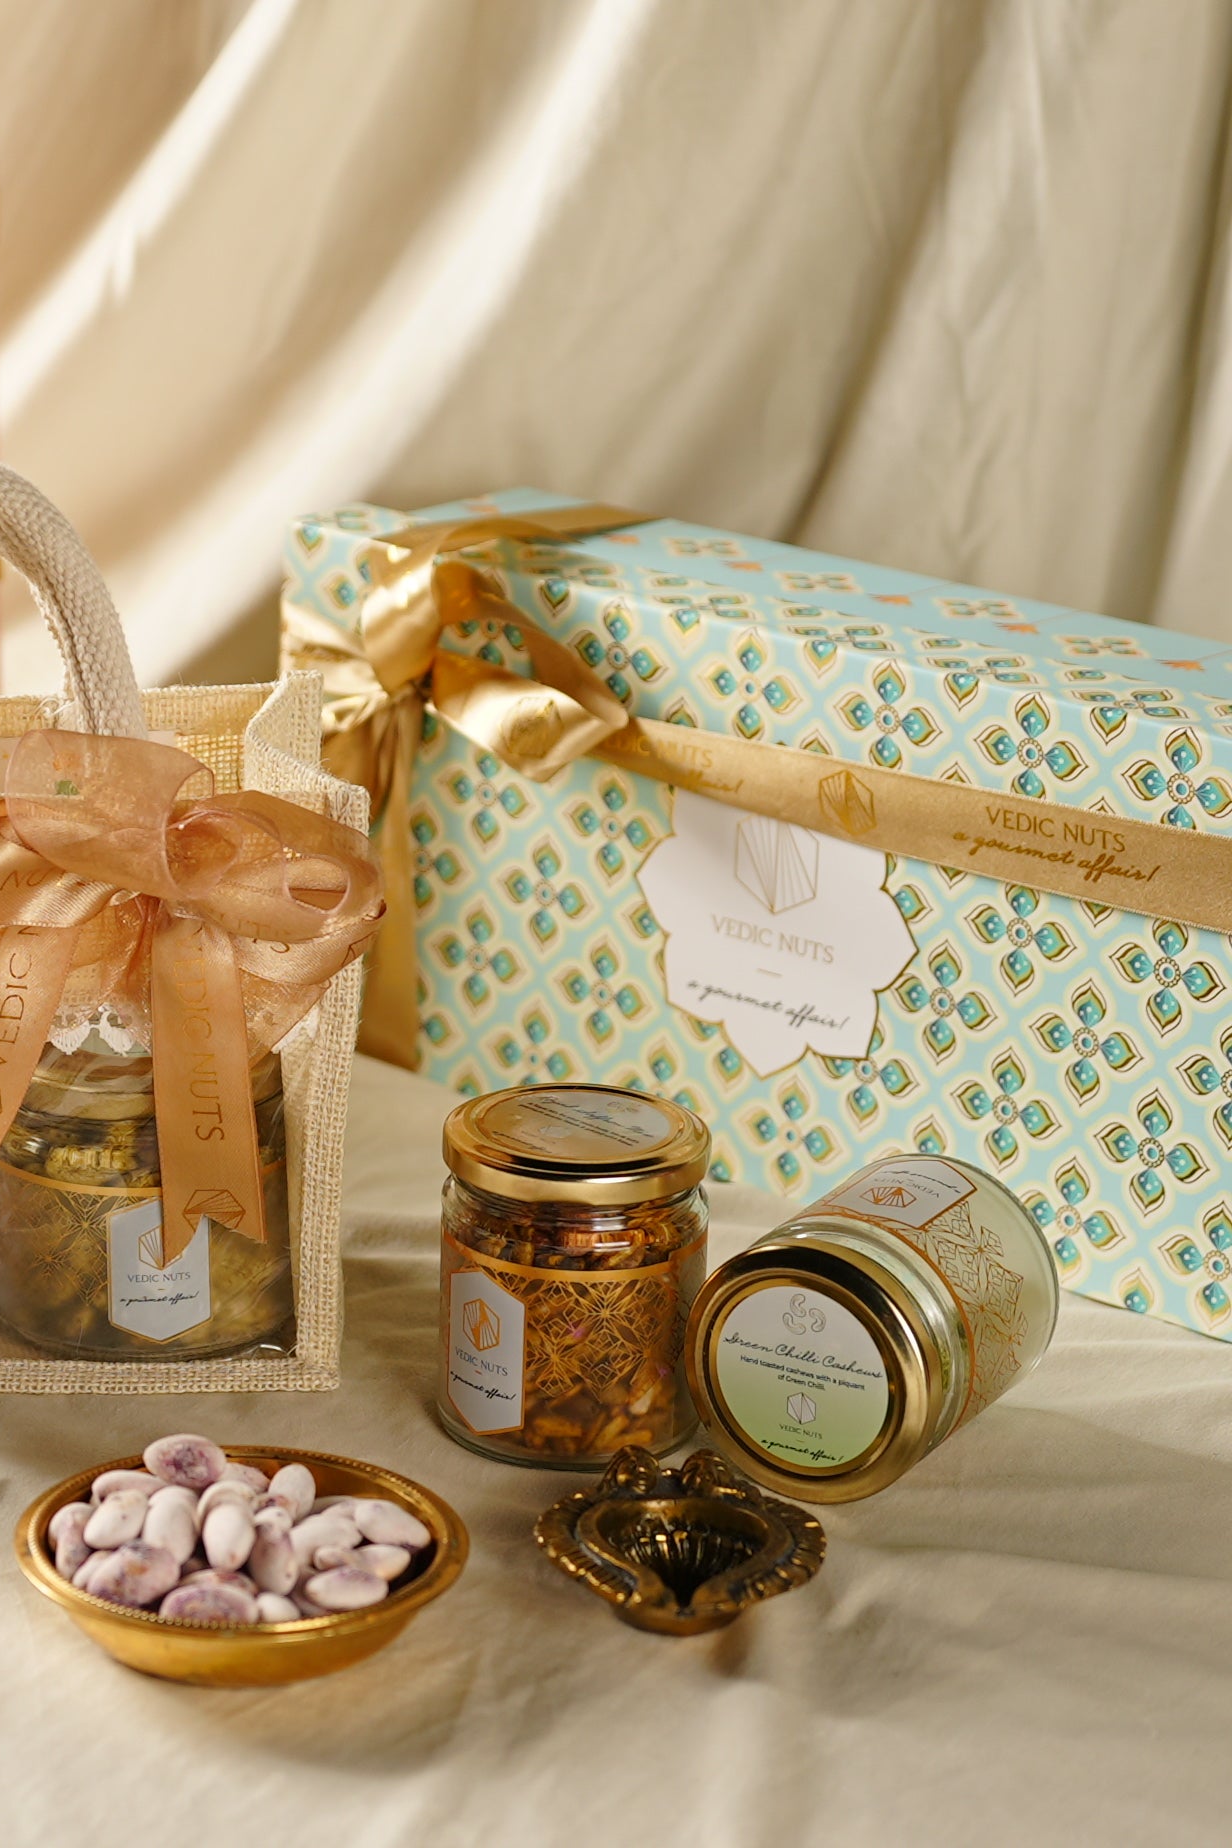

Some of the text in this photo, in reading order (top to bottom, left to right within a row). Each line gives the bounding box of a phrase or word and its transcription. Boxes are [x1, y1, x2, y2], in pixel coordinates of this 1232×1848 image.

[985, 805, 1127, 854] VEDIC NUTS
[952, 831, 1161, 883] a gourmet affair!
[710, 913, 836, 965] VEDIC NUTS
[687, 980, 851, 1031] a gourmet affair!
[173, 924, 226, 1142] VEDIC NUTS
[127, 1271, 191, 1284] VEDIC NUTS
[455, 1346, 508, 1377] VEDIC NUTS
[723, 1331, 884, 1379] Green Chilli Cashews
[779, 1423, 823, 1440] VEDIC NUTS
